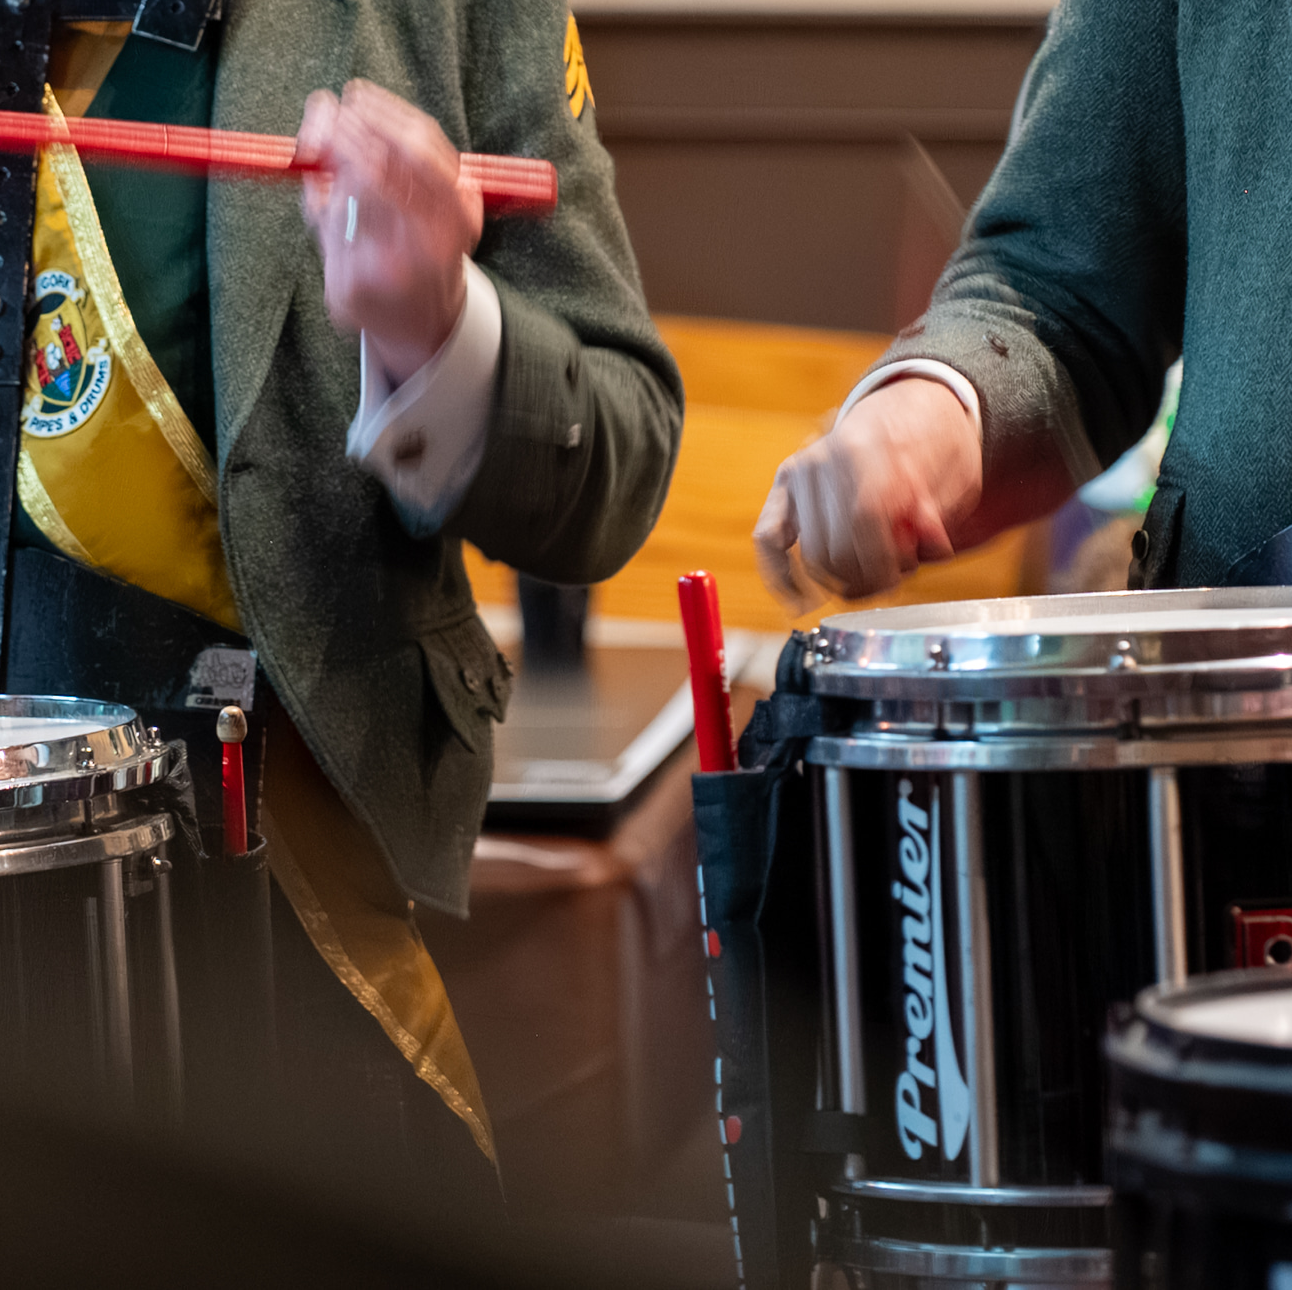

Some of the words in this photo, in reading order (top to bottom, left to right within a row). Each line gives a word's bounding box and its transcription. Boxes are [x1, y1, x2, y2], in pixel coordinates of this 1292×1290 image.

[28, 416, 63, 432] PIPES
[69, 412, 79, 426] &
[79, 360, 109, 414] DRUMS
[892, 779, 939, 1160] Premier
